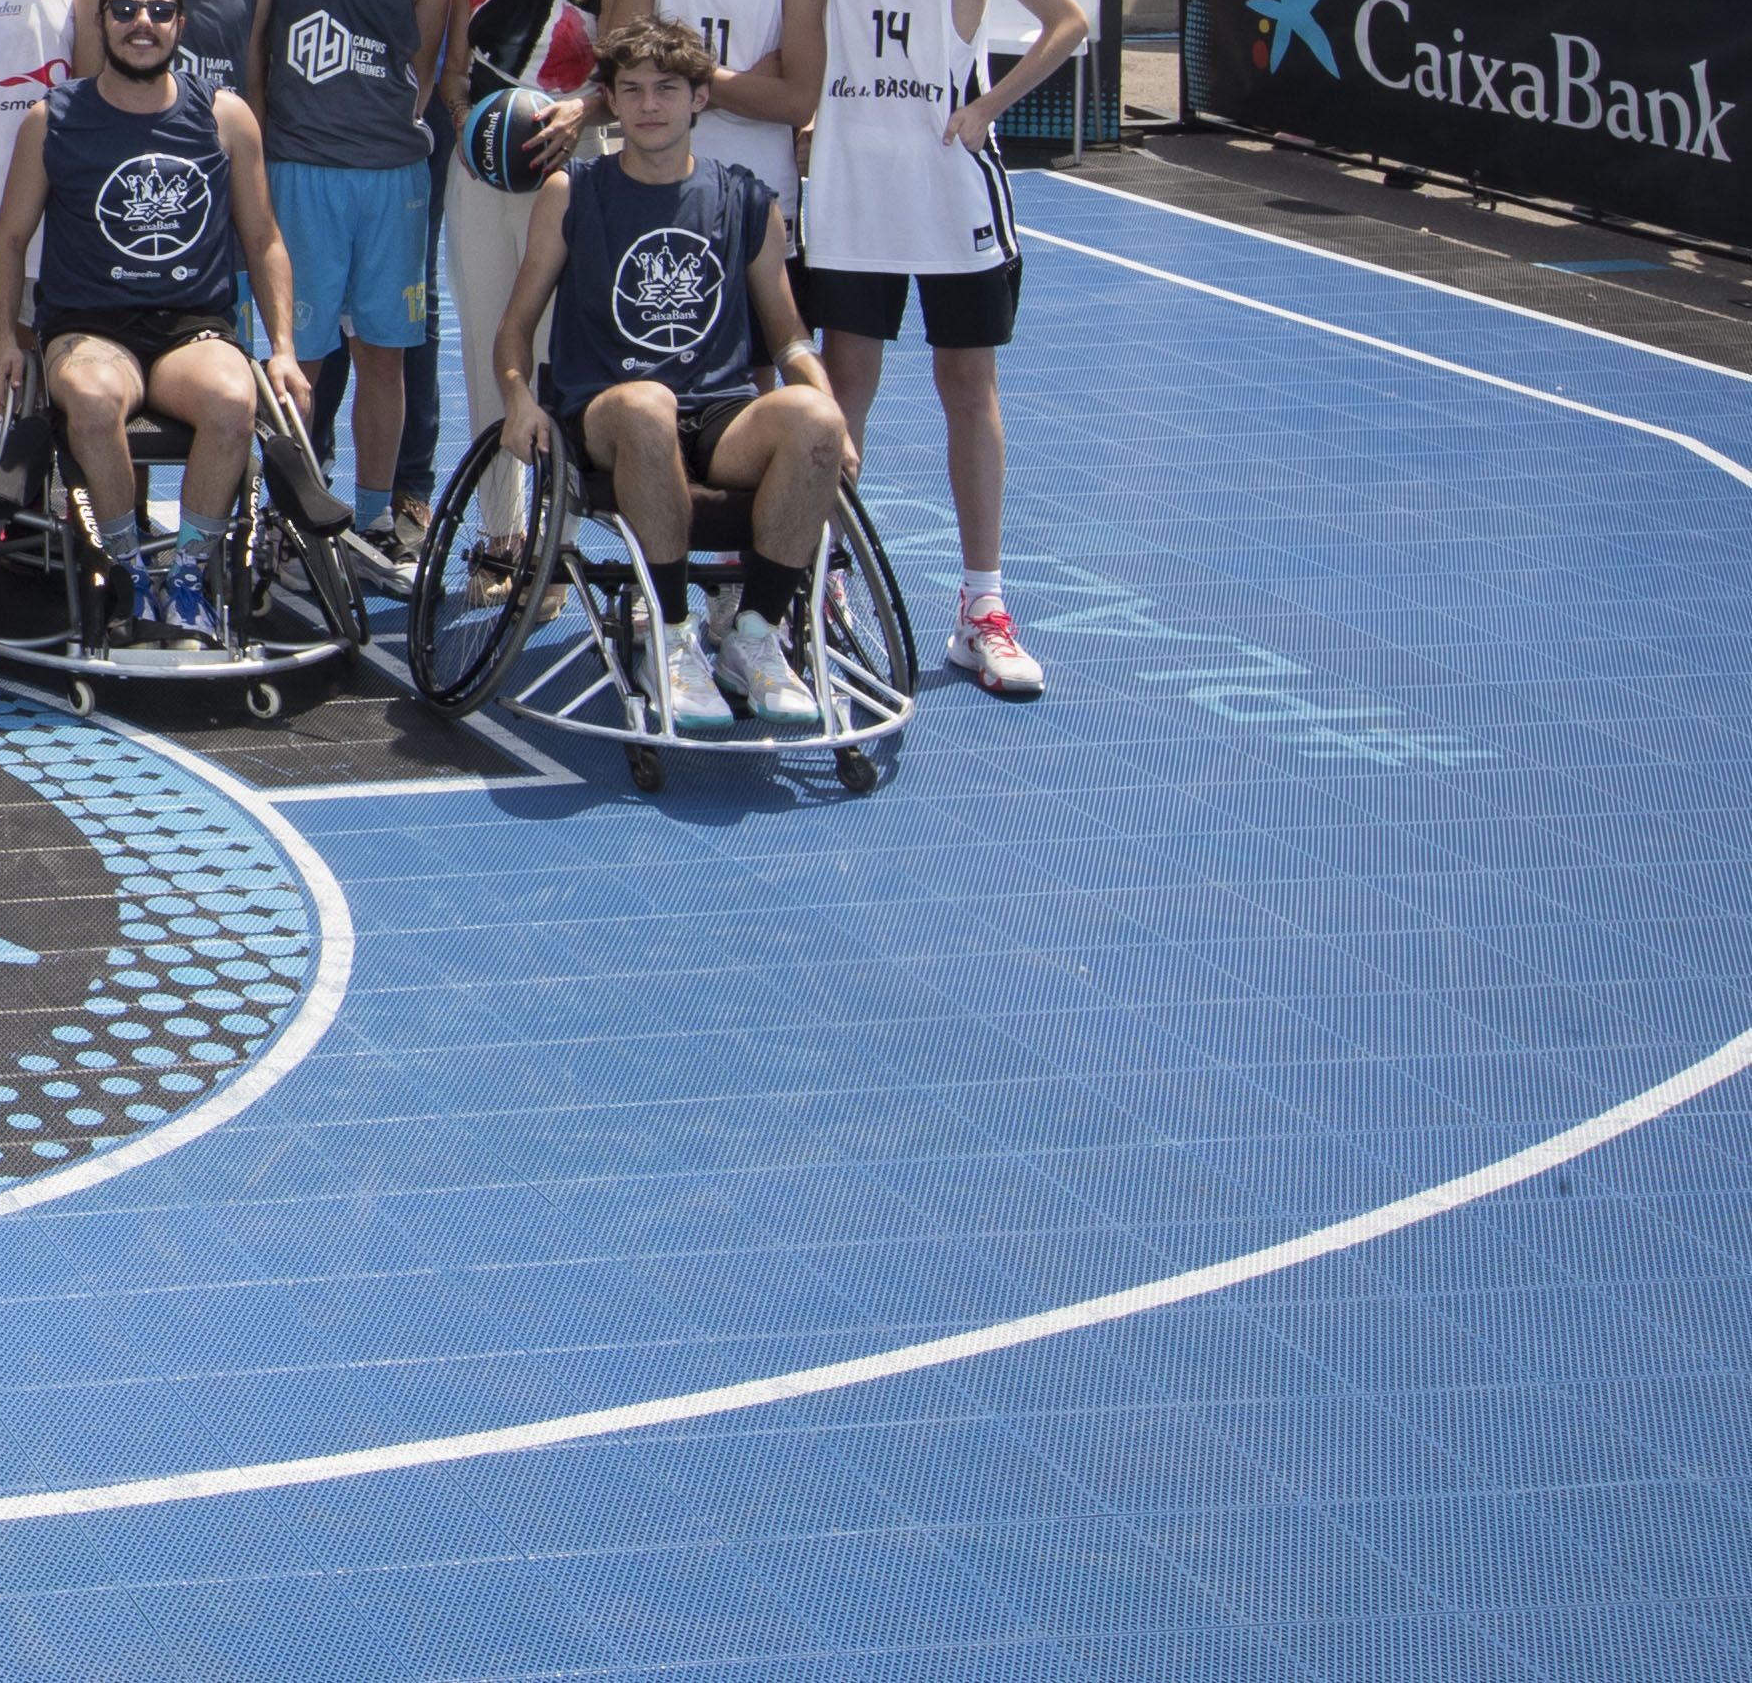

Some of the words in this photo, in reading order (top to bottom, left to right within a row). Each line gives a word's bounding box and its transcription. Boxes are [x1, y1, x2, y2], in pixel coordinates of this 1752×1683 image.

[700, 16, 730, 67] 11
[872, 9, 911, 59] 14
[482, 110, 502, 171] CaixaBank
[128, 219, 182, 233] CaixaBank
[640, 308, 699, 323] CaixaBank
